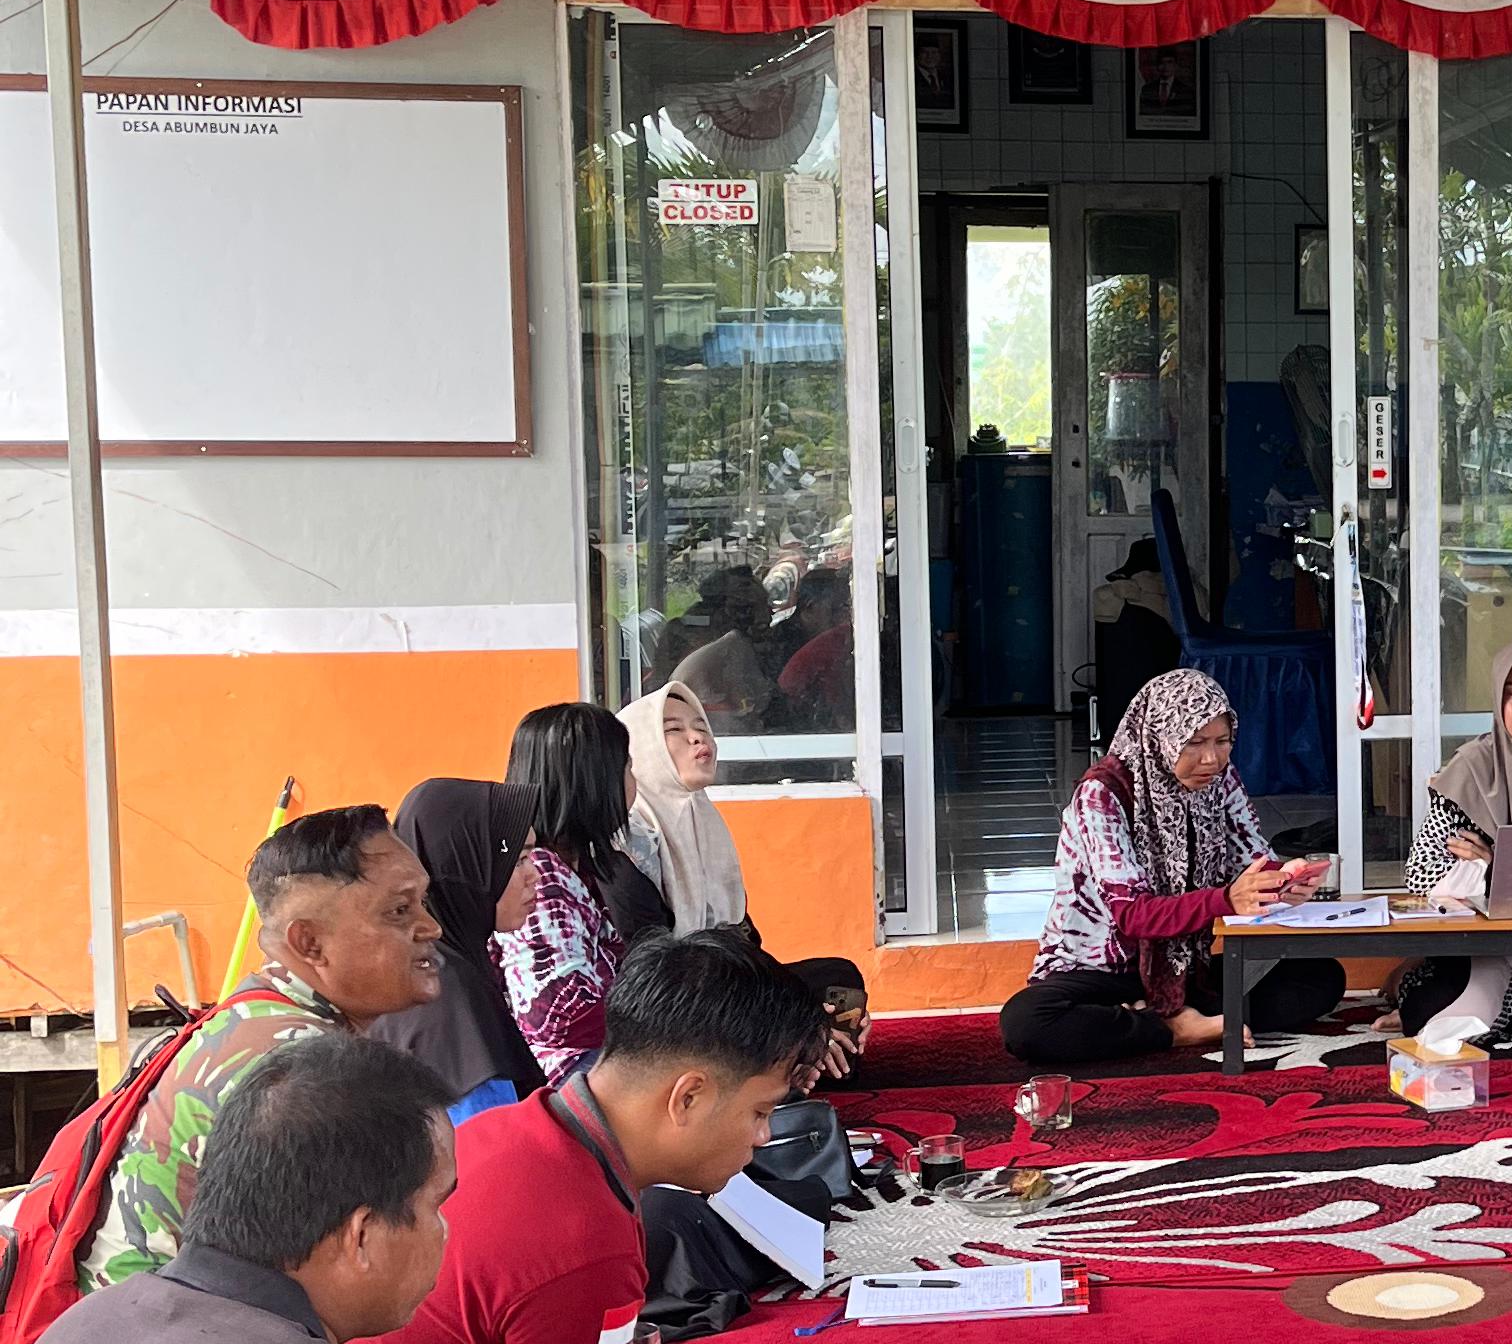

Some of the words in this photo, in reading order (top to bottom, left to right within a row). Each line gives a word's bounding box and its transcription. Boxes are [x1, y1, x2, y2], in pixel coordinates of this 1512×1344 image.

[96, 93, 168, 110] PAPAN
[177, 94, 302, 114] INFORMASI
[122, 121, 160, 133] DESA
[164, 122, 240, 135] ABUMBUN
[243, 123, 279, 135] JAYA
[663, 204, 753, 221] CLOSED
[1375, 402, 1385, 460] GESER
